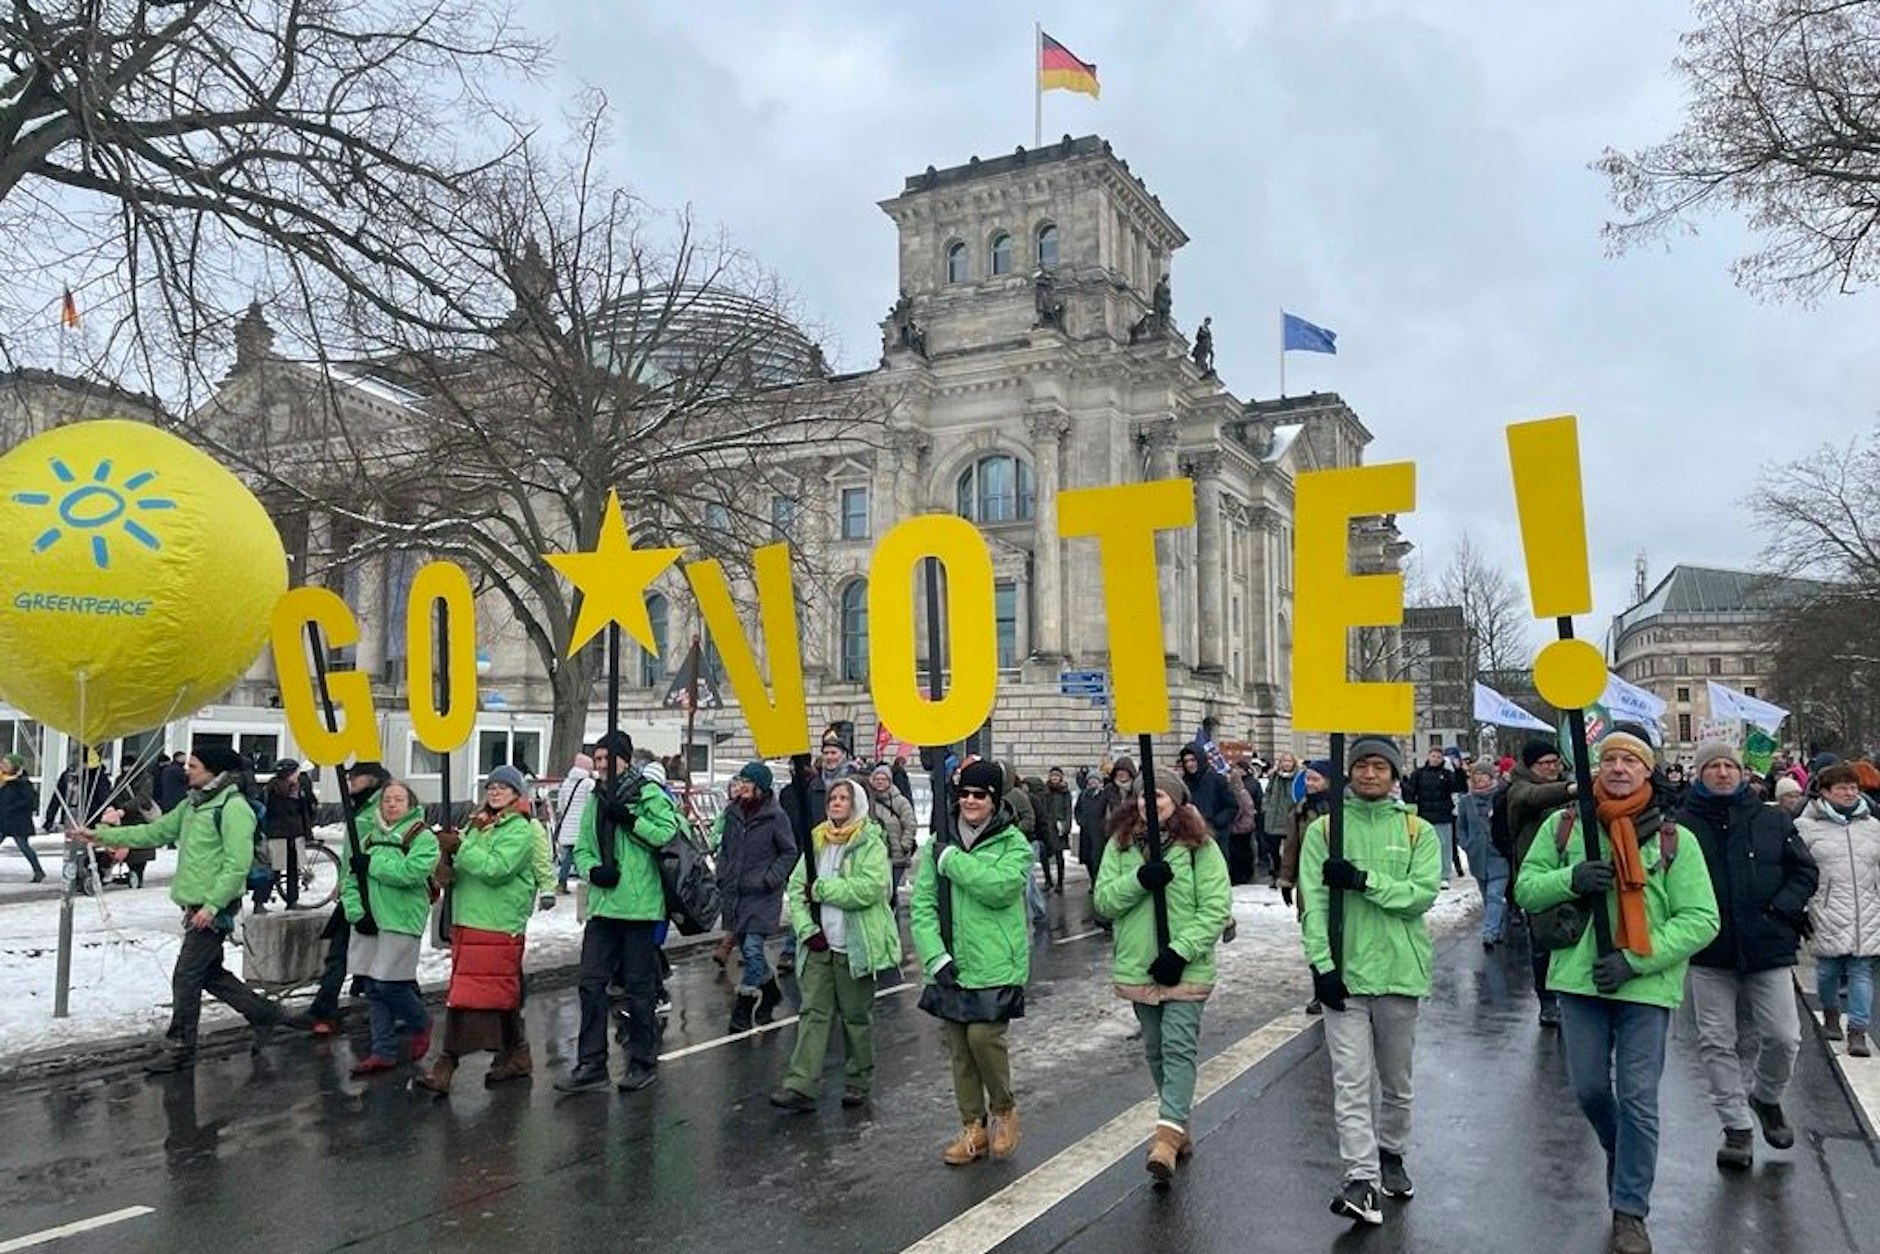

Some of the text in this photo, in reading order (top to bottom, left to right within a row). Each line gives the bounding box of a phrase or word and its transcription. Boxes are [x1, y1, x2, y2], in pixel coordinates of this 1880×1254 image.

[14, 592, 153, 616] GREENPEACE
[271, 415, 1607, 767] GO VOTE!
